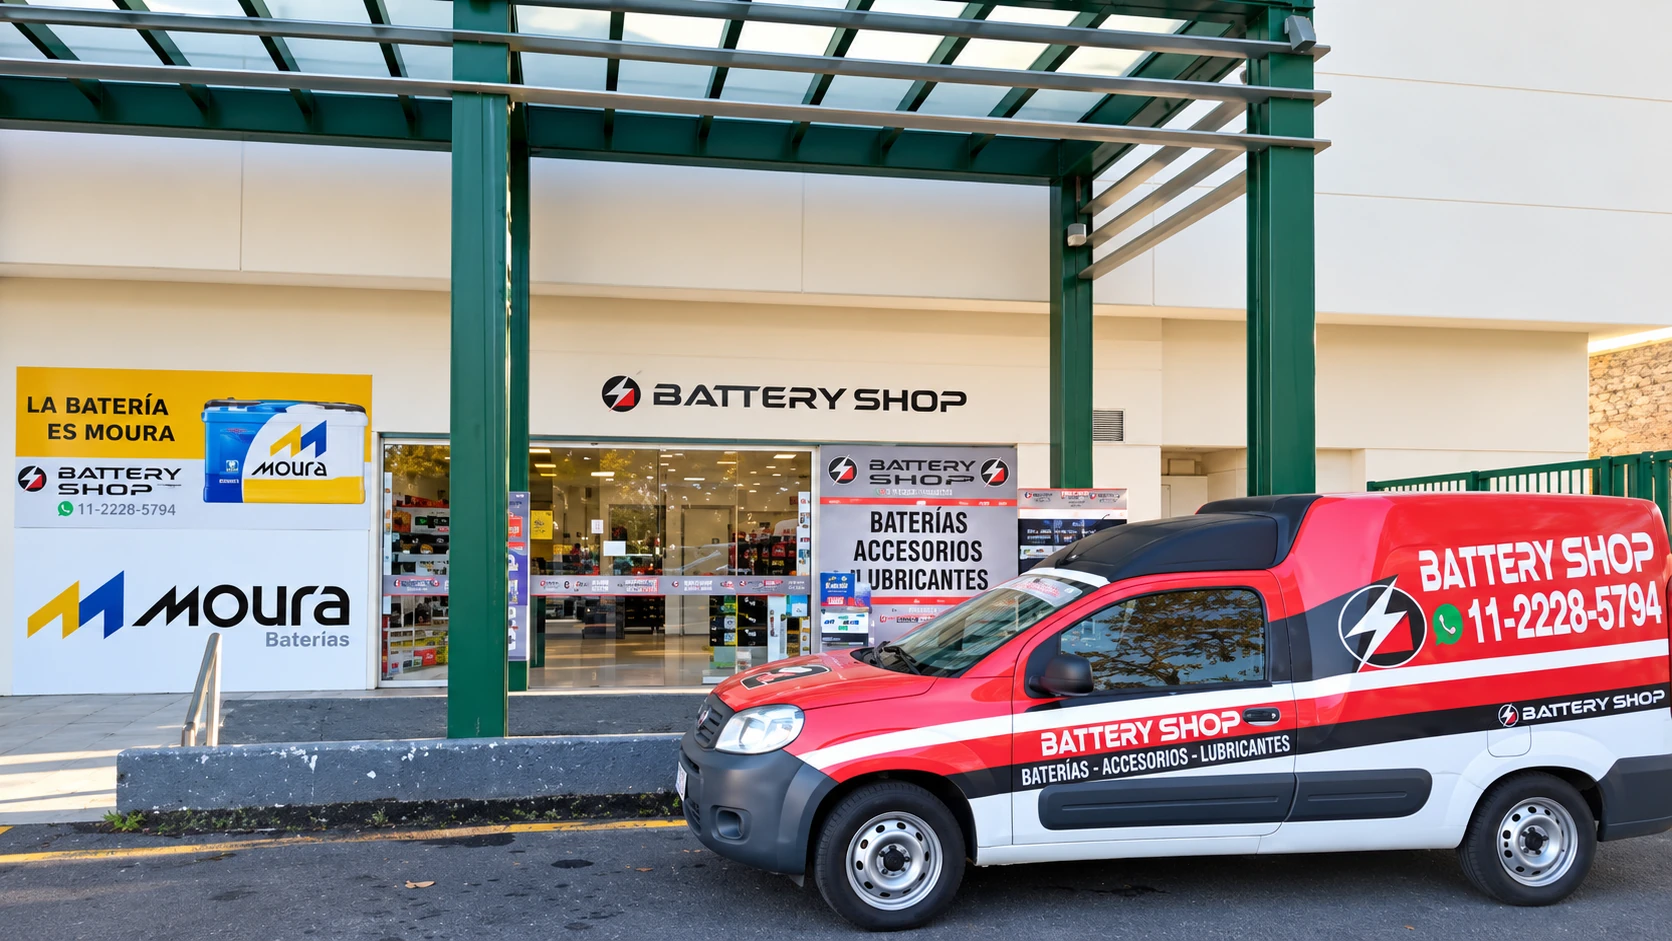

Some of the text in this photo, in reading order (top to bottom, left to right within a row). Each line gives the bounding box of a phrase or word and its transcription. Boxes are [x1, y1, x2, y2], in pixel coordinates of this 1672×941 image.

[27, 393, 169, 416] LA BATERÍA
[653, 383, 968, 412] BATTERY SHOP
[48, 423, 175, 442] ES MOURA
[58, 467, 182, 481] BATTERY
[869, 459, 976, 471] BATTERY
[58, 483, 153, 496] SHOP
[869, 474, 975, 486] SHOP
[78, 503, 176, 516] 11-2228-5794
[870, 506, 968, 534] BATERÍAS
[853, 540, 983, 563] ACCESORIOS
[1418, 532, 1654, 592] BATTERY SHOP
[1468, 580, 1662, 643] 11-2228-5794
[265, 631, 350, 647] Baterías
[1522, 689, 1665, 720] BATTERY SHOP
[1040, 710, 1241, 757] BATTERY SHOP
[1021, 759, 1089, 787] BATERÍAS
[1102, 747, 1188, 776] ACCESORIOS
[1201, 735, 1291, 763] LUBRICANTES
